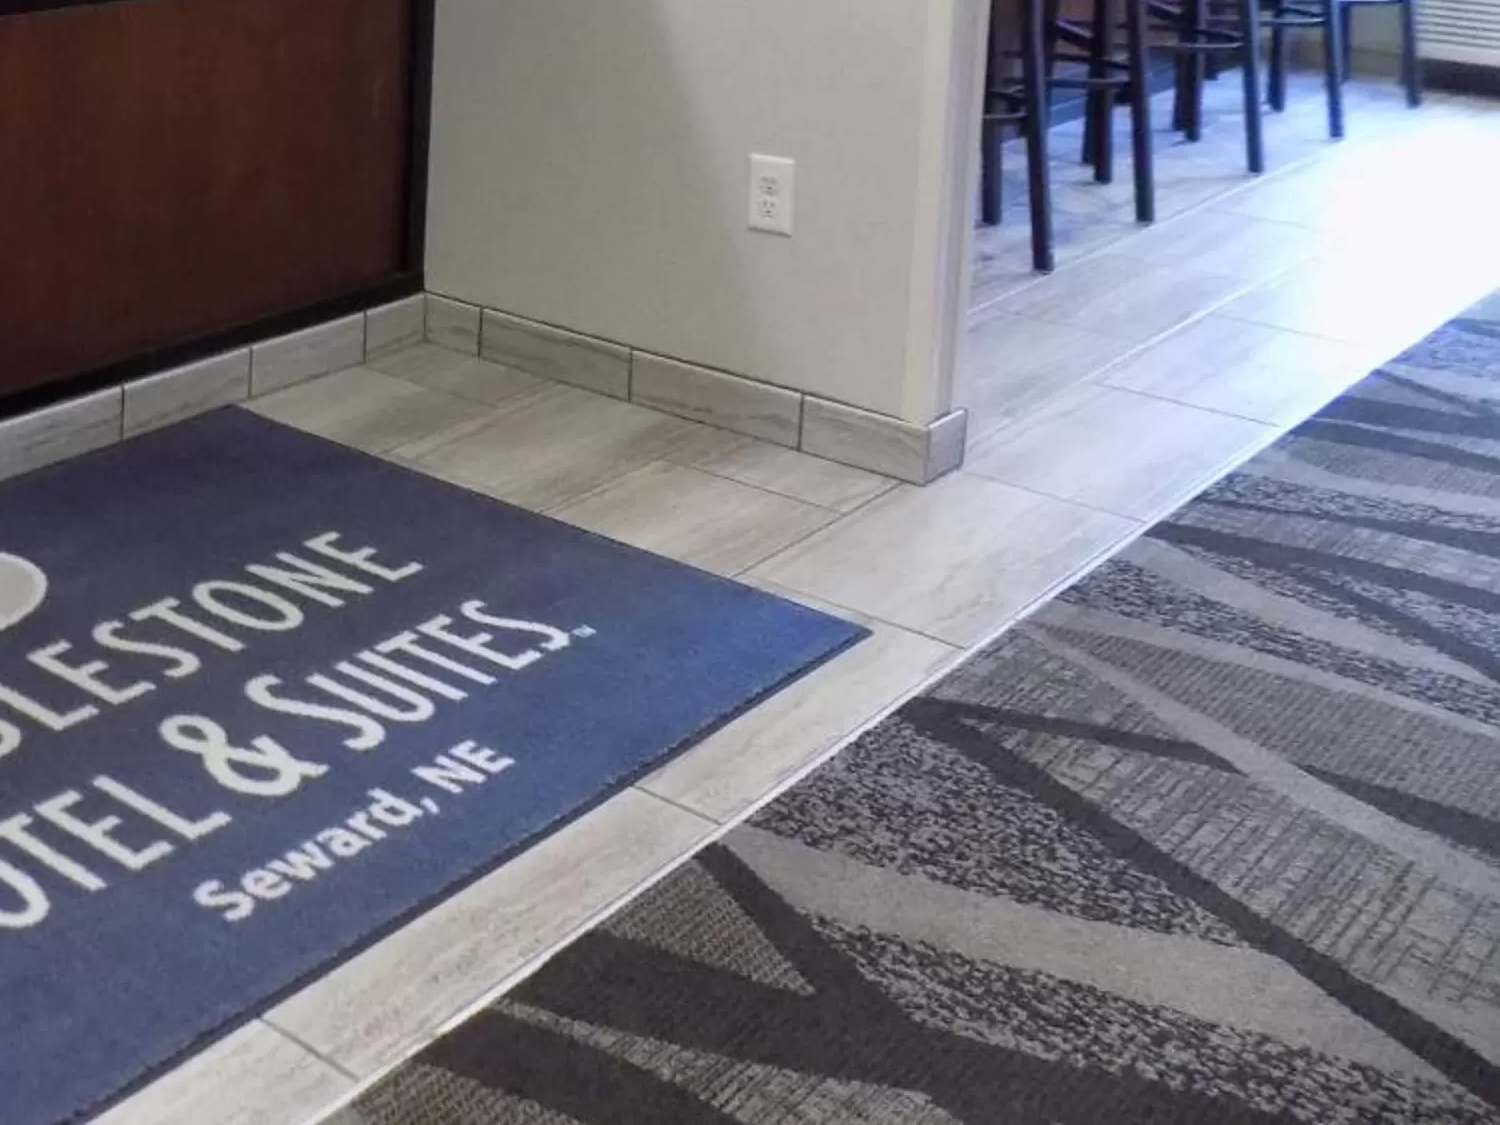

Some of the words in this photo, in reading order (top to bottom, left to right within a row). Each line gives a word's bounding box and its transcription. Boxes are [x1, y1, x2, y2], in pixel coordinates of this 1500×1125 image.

[158, 713, 330, 798] &
[192, 786, 441, 922] Seward,
[410, 738, 517, 795] NE
